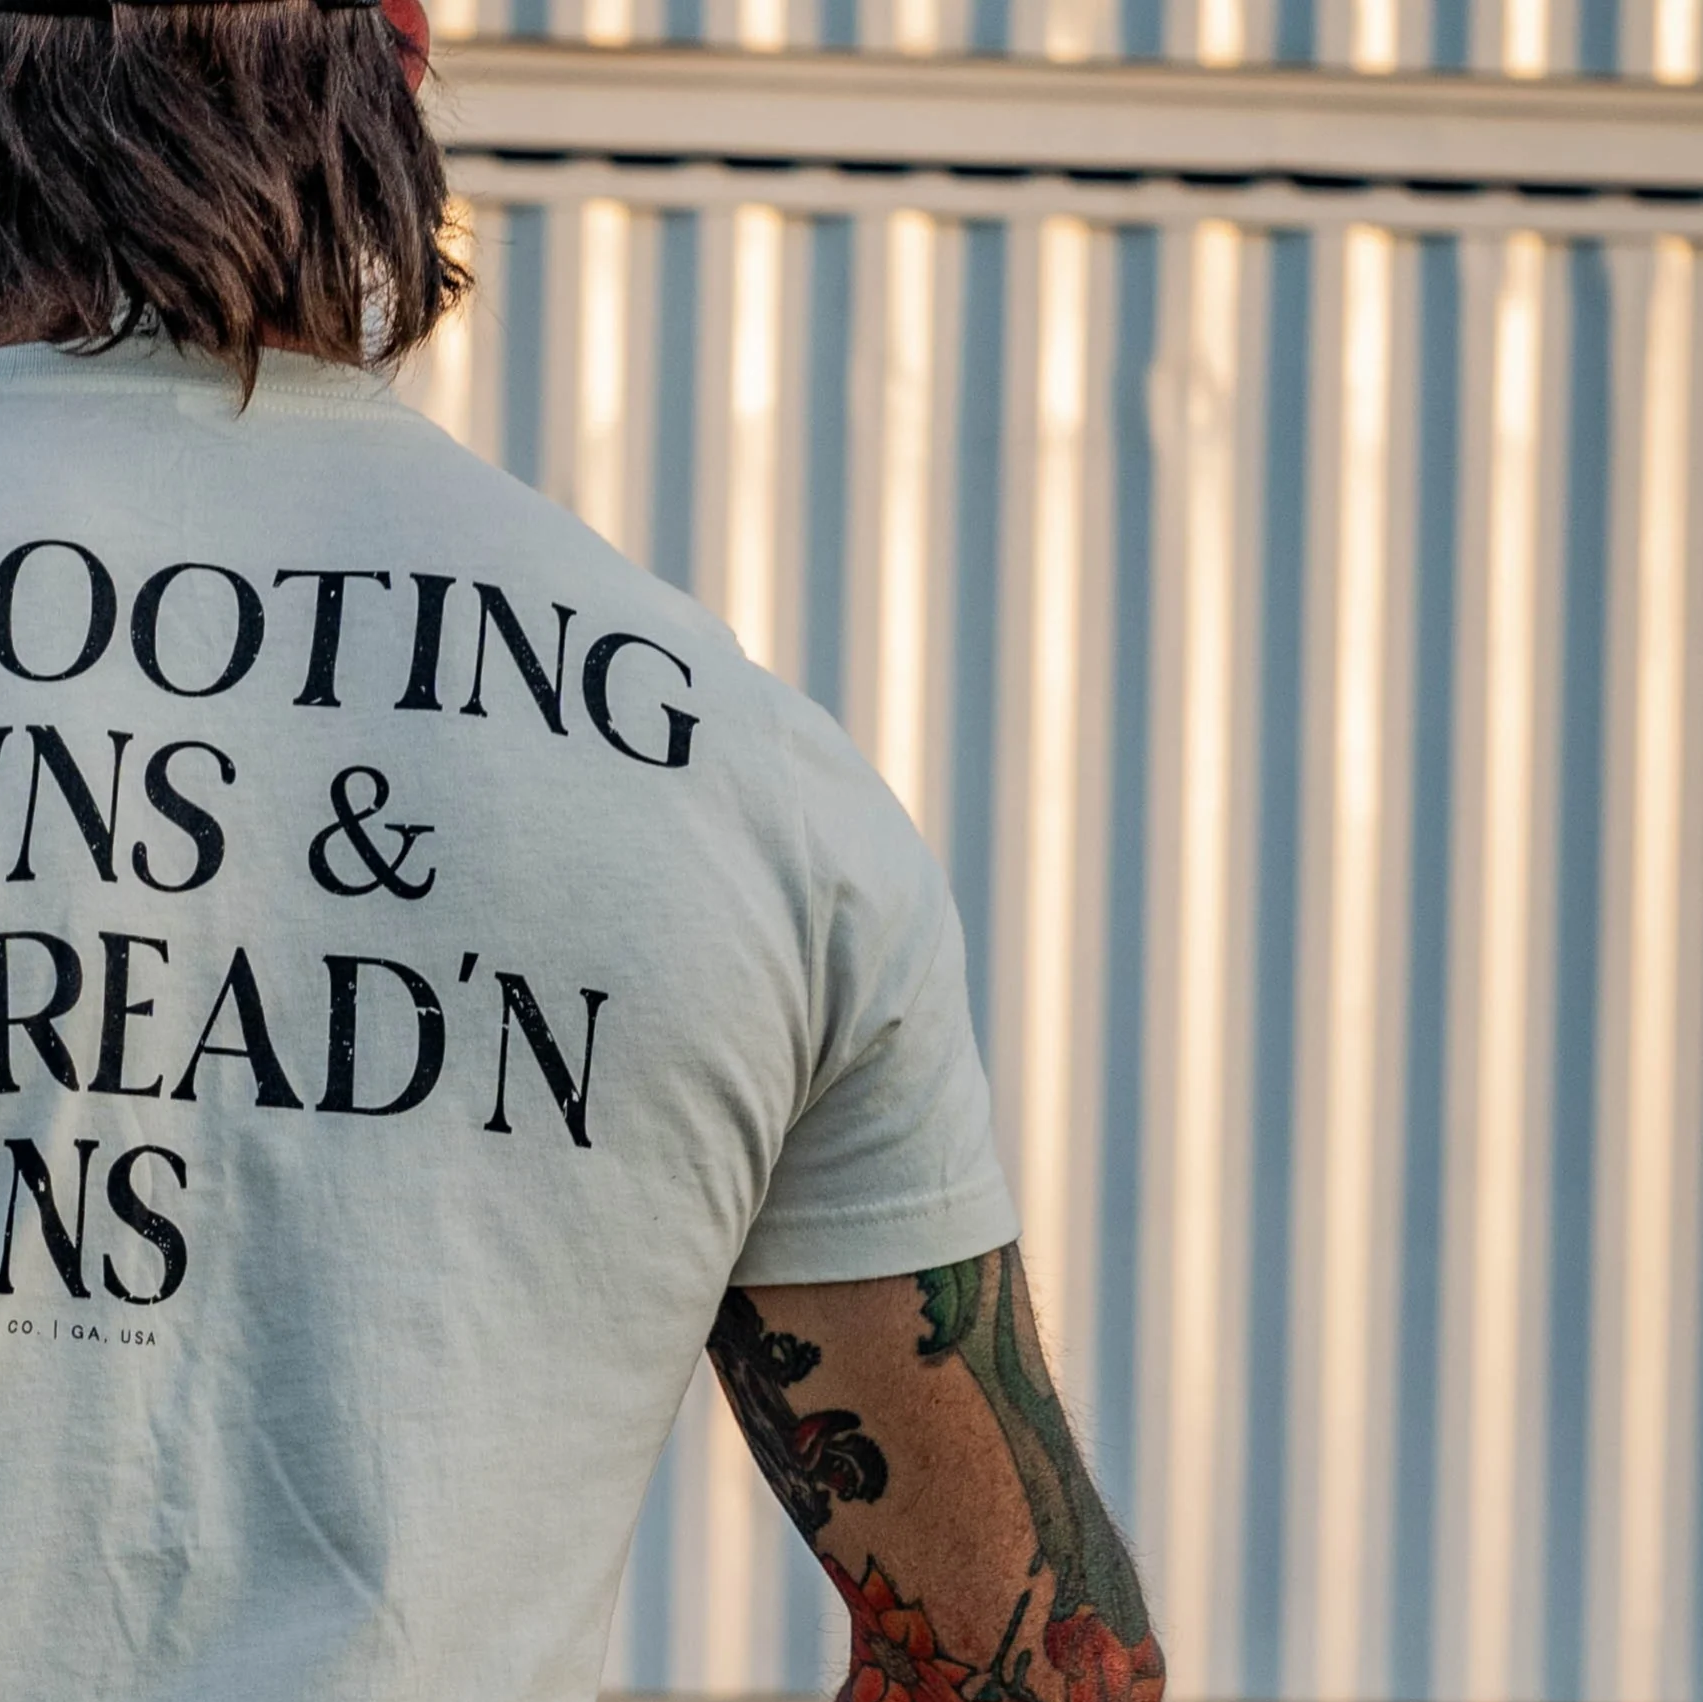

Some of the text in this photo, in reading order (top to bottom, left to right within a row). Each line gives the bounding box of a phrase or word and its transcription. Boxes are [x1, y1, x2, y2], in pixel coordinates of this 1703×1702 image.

[308, 765, 437, 901] &
[7, 1319, 41, 1335] CO.
[121, 1329, 156, 1345] USA
